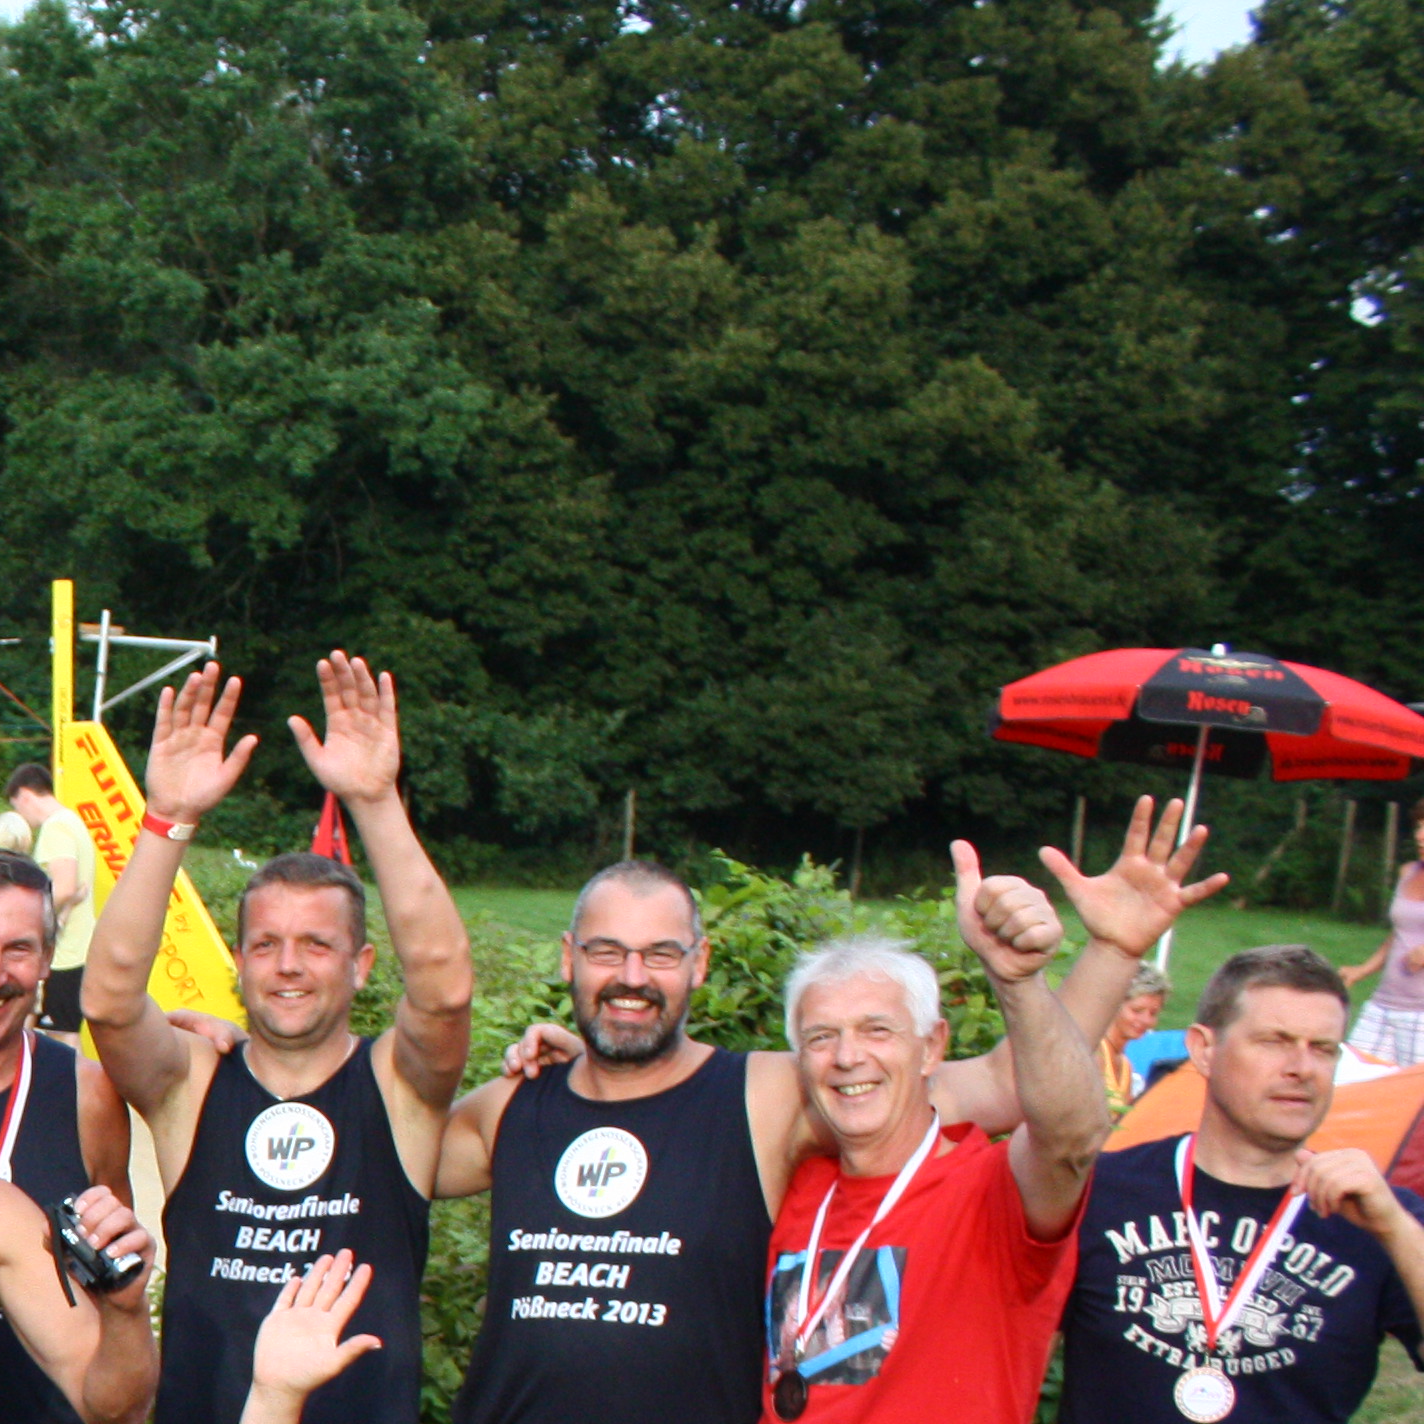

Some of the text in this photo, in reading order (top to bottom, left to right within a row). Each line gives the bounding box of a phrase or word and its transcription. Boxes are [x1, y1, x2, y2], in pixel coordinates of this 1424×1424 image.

[267, 1137, 316, 1160] WP
[577, 1162, 628, 1187] WP
[215, 1190, 361, 1221] Seniorenfinale
[235, 1226, 321, 1252] BEACH
[507, 1227, 682, 1255] Seniorenfinale
[210, 1257, 296, 1284] Pößneck
[534, 1261, 631, 1289] BEACH
[510, 1295, 668, 1327] Pößneck 2013
[1114, 1285, 1145, 1312] 19
[1122, 1322, 1198, 1370] EXTRA
